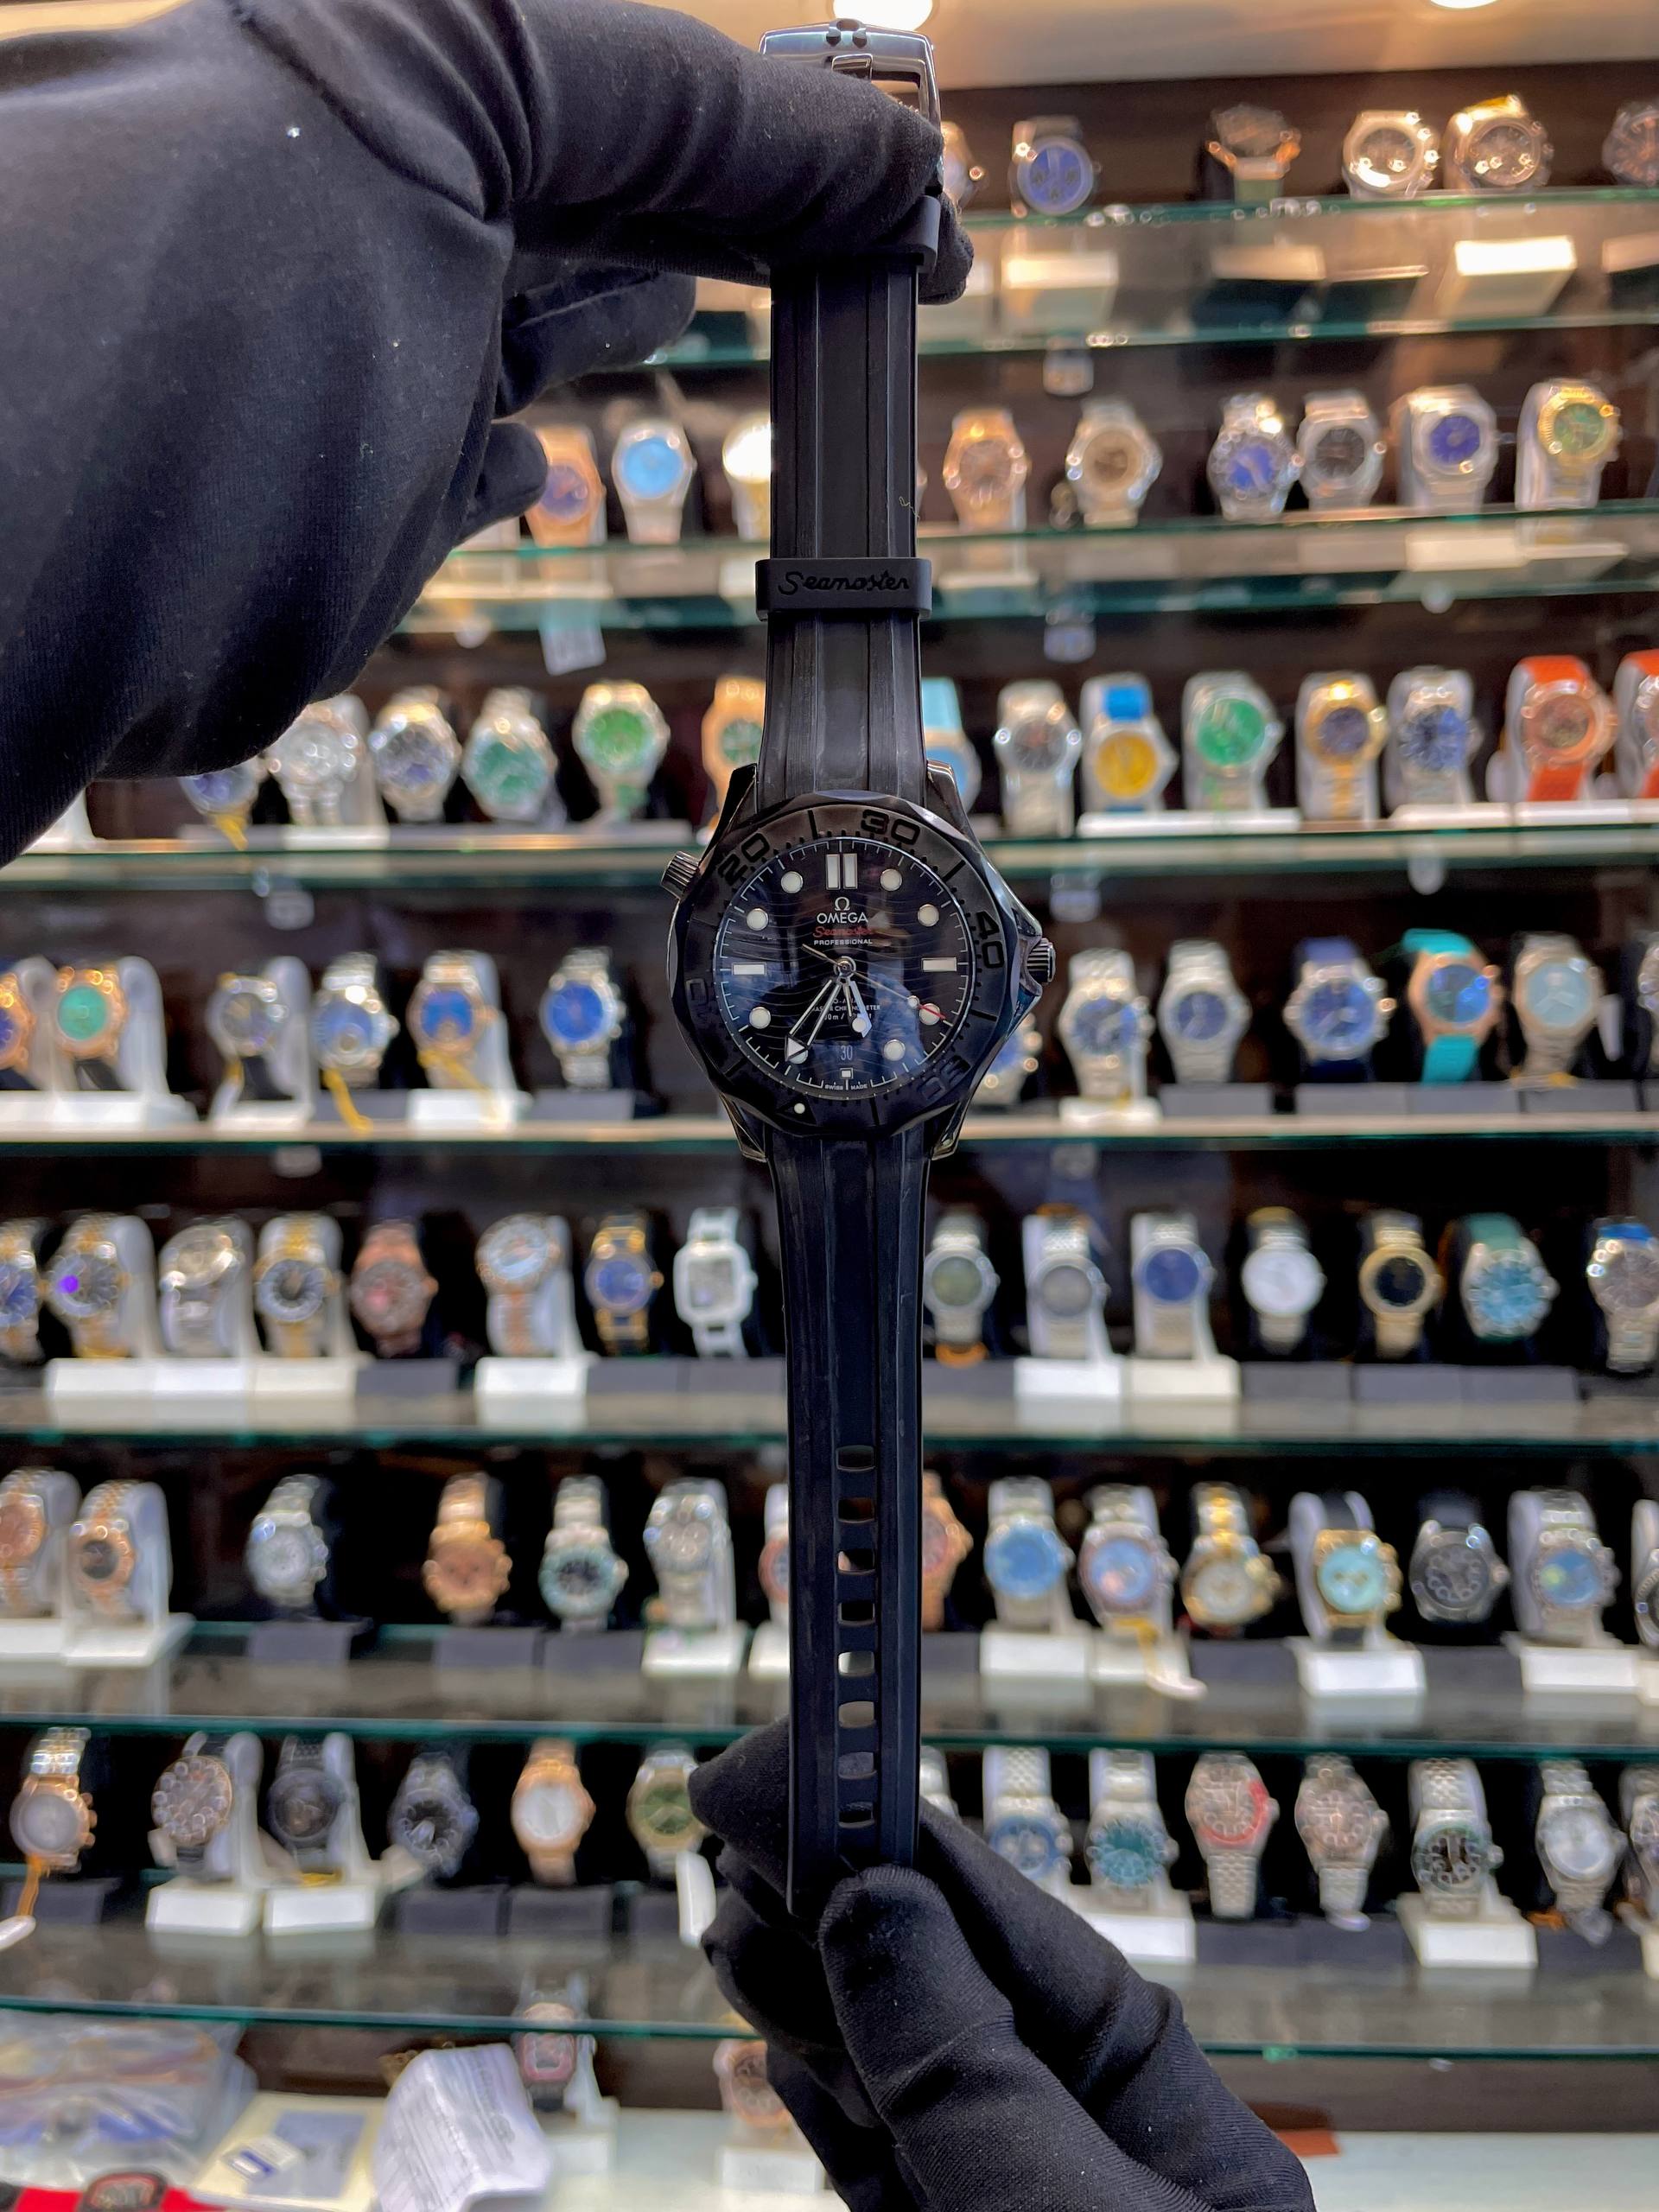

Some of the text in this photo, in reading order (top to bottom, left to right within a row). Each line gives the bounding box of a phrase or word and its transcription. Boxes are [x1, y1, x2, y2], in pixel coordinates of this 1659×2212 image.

[778, 569, 910, 595] Seamaster
[861, 809, 920, 845] 30
[717, 832, 770, 886] 20
[817, 912, 868, 924] OMEGA
[976, 912, 1004, 969] 40
[840, 1045, 853, 1060] 30
[917, 1055, 970, 1100] 50
